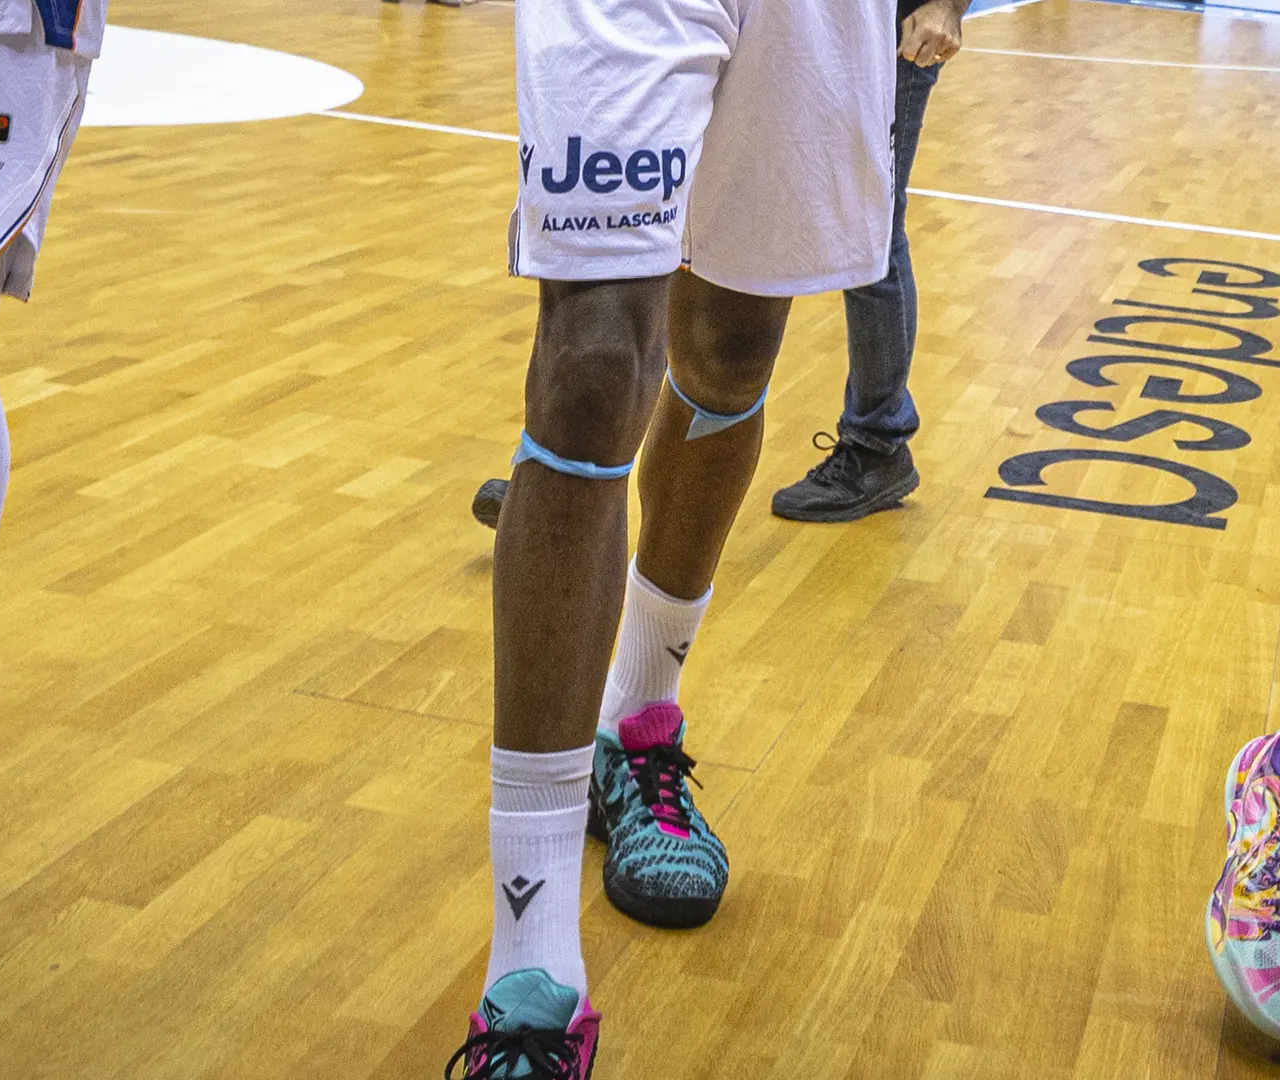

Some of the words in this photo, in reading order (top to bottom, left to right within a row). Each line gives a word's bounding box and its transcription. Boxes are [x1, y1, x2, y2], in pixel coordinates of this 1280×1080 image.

[541, 135, 687, 201] Jeep
[541, 213, 601, 233] ÁLAVA
[606, 203, 679, 230] LASCARAY
